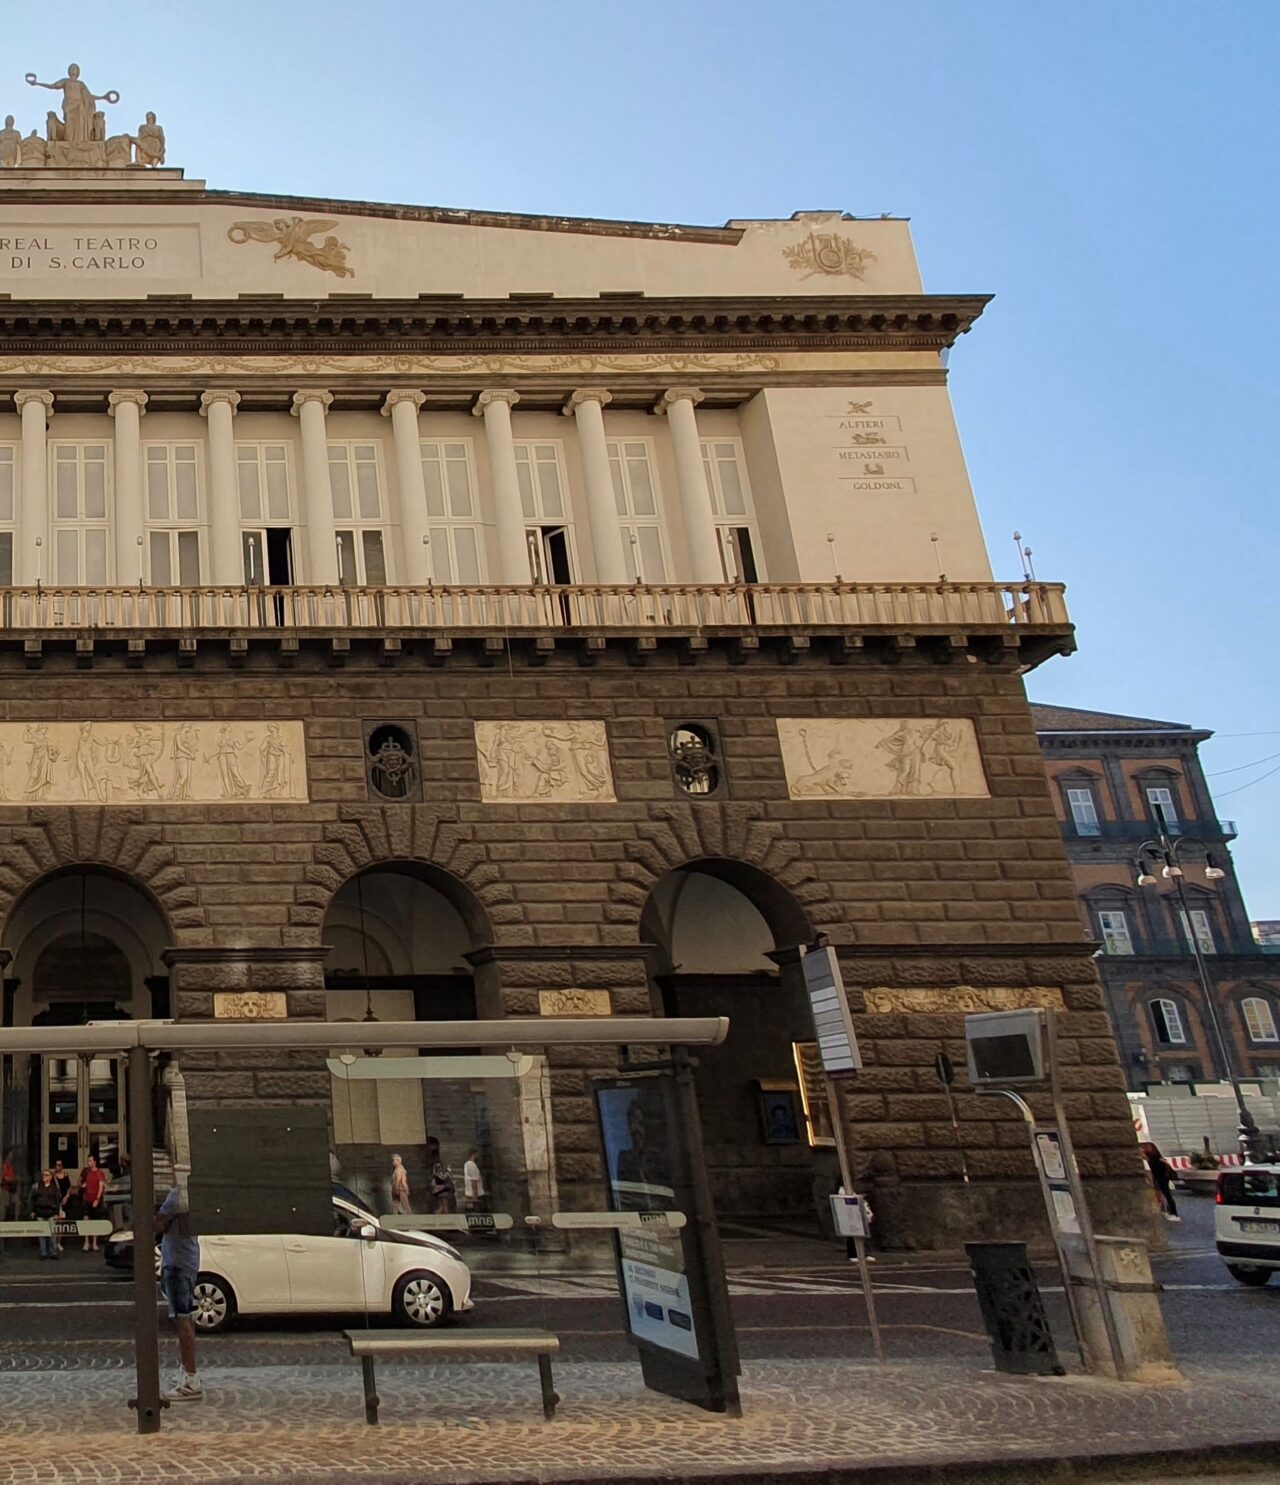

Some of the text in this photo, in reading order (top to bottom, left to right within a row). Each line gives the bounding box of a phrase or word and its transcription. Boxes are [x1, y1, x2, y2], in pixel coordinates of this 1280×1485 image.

[73, 237, 158, 250] TEATRO
[10, 256, 32, 269] DI
[838, 420, 884, 430] ALFIERI
[838, 451, 901, 460] METASTASIO
[852, 481, 904, 490] GOLDONI
